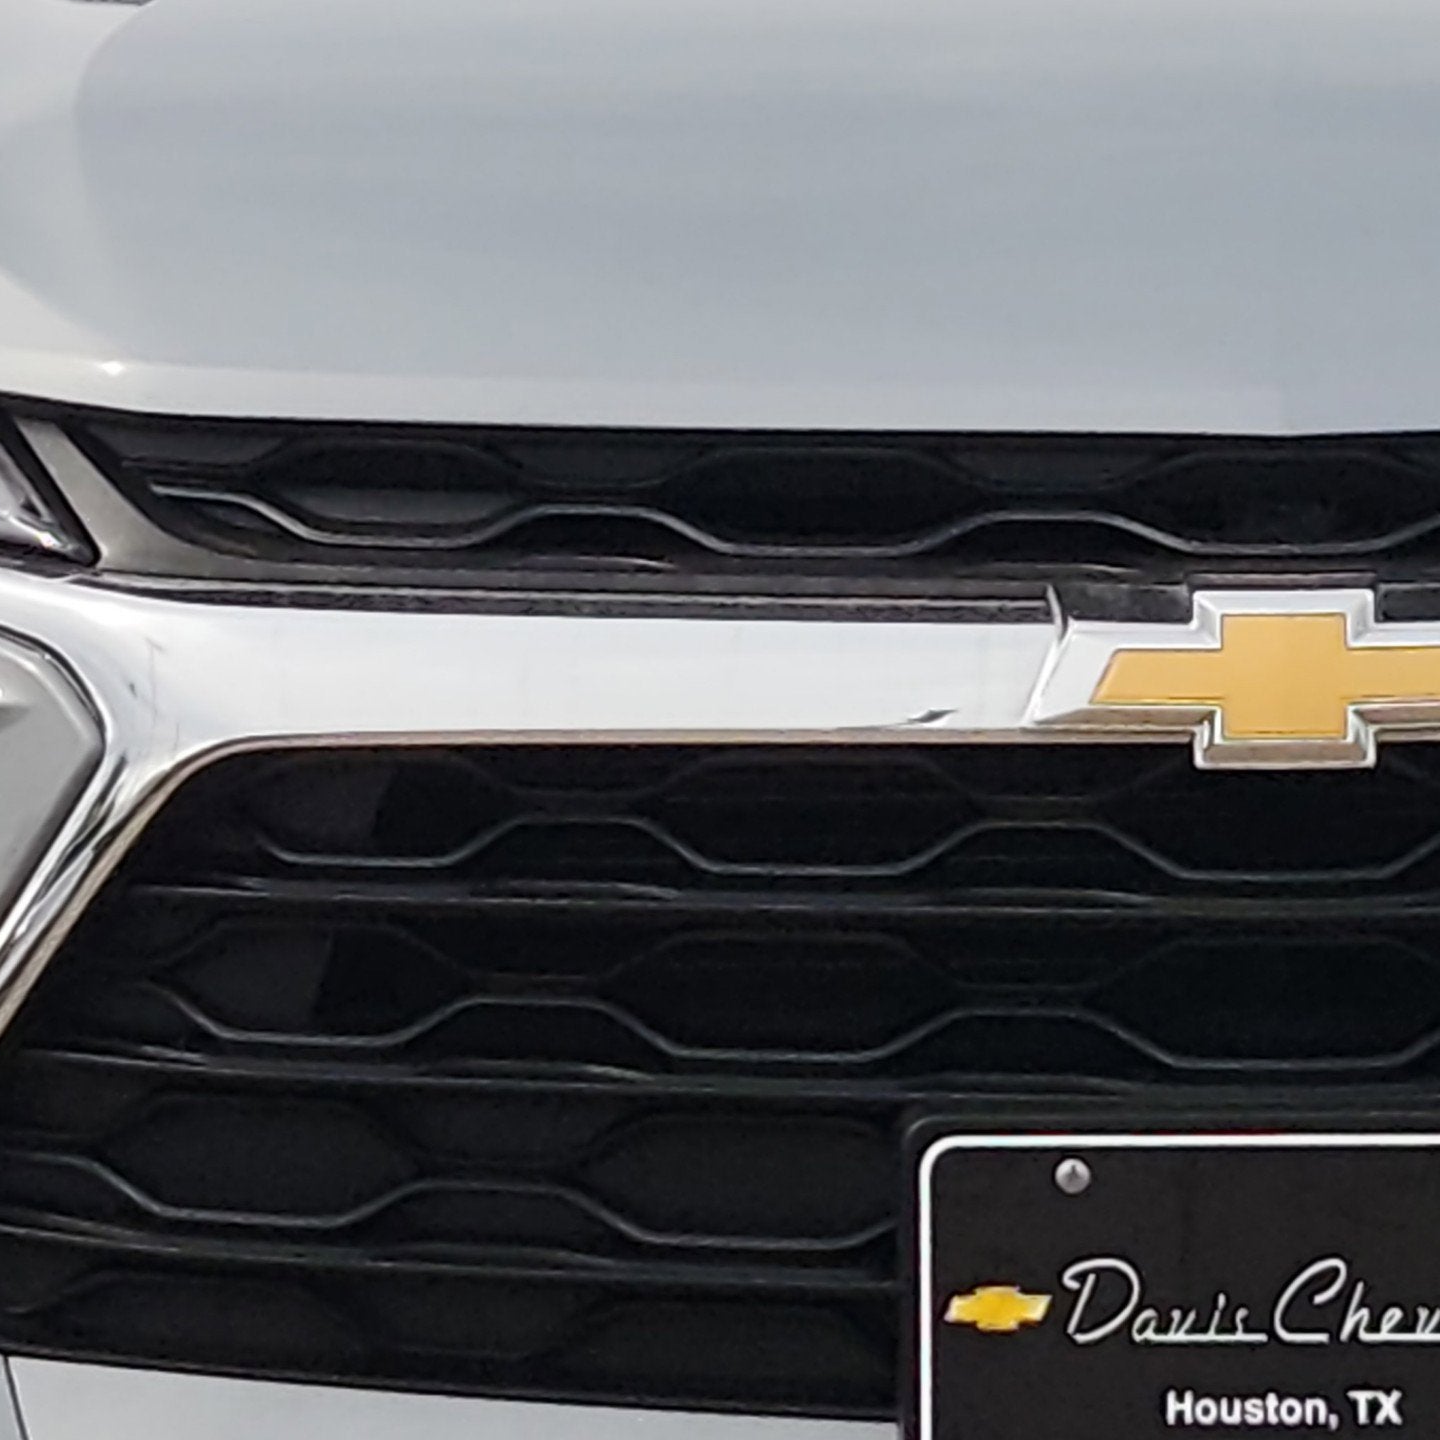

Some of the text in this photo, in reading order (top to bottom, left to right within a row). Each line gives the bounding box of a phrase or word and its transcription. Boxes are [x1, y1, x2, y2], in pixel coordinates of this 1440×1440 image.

[1061, 1257, 1269, 1345] Davis
[1165, 1390, 1403, 1430] Houston, TX
